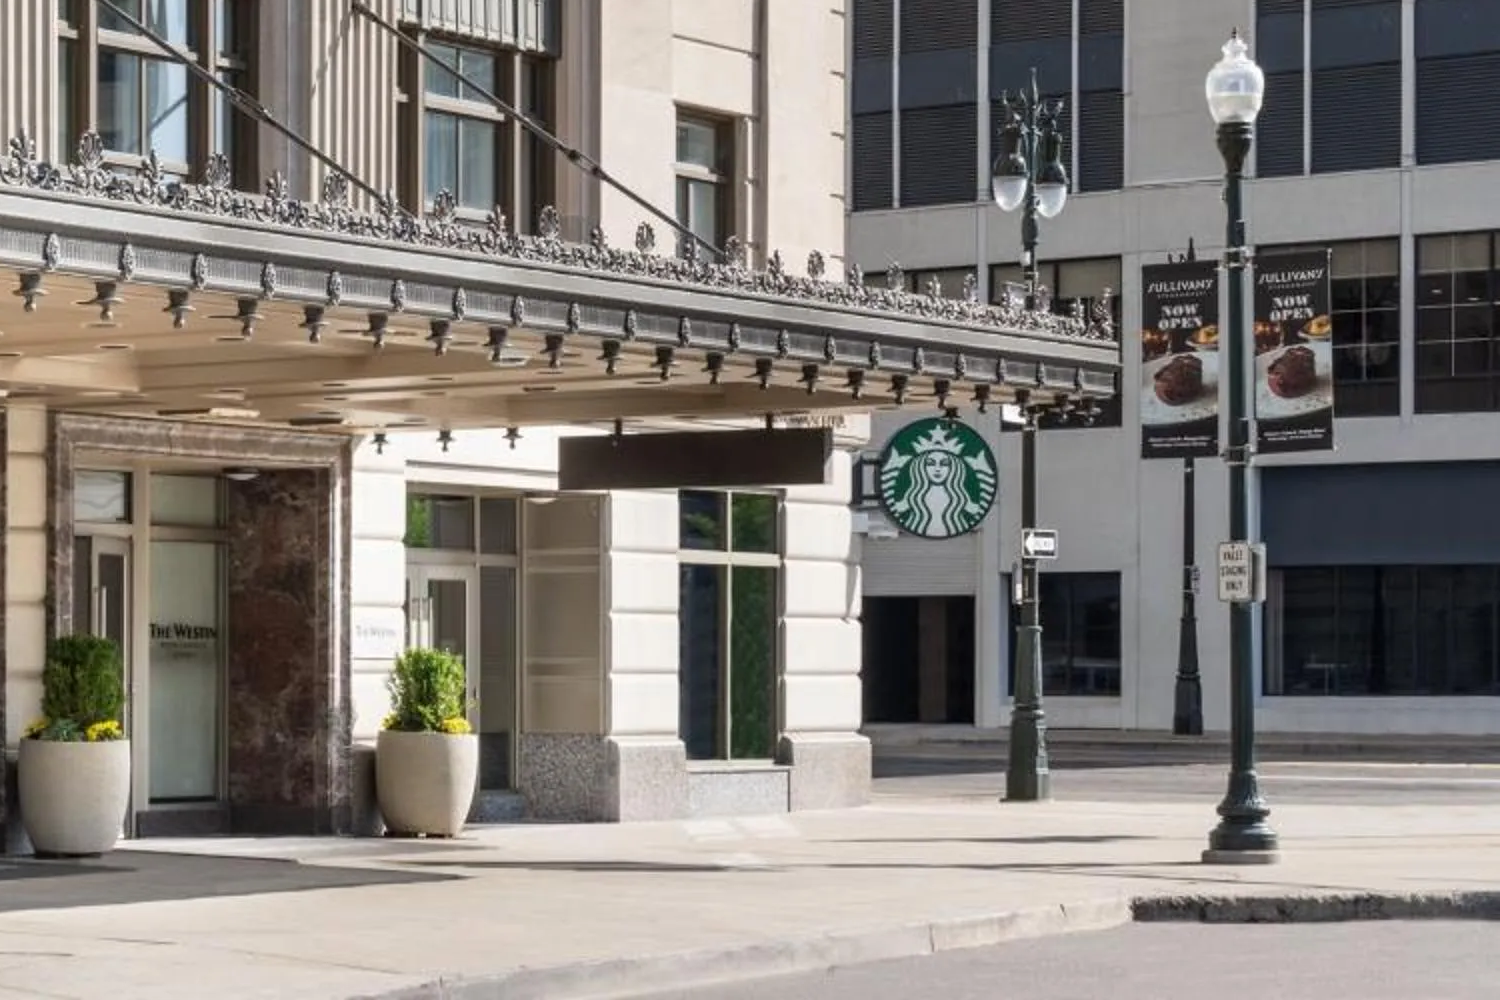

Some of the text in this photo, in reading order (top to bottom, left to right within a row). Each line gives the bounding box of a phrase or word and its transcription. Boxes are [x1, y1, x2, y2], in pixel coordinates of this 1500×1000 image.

[1272, 294, 1311, 308] NOW
[1161, 304, 1199, 317] NOW
[1269, 307, 1314, 322] OPEN
[1158, 316, 1203, 330] OPEN
[148, 621, 218, 640] THE WESTIN
